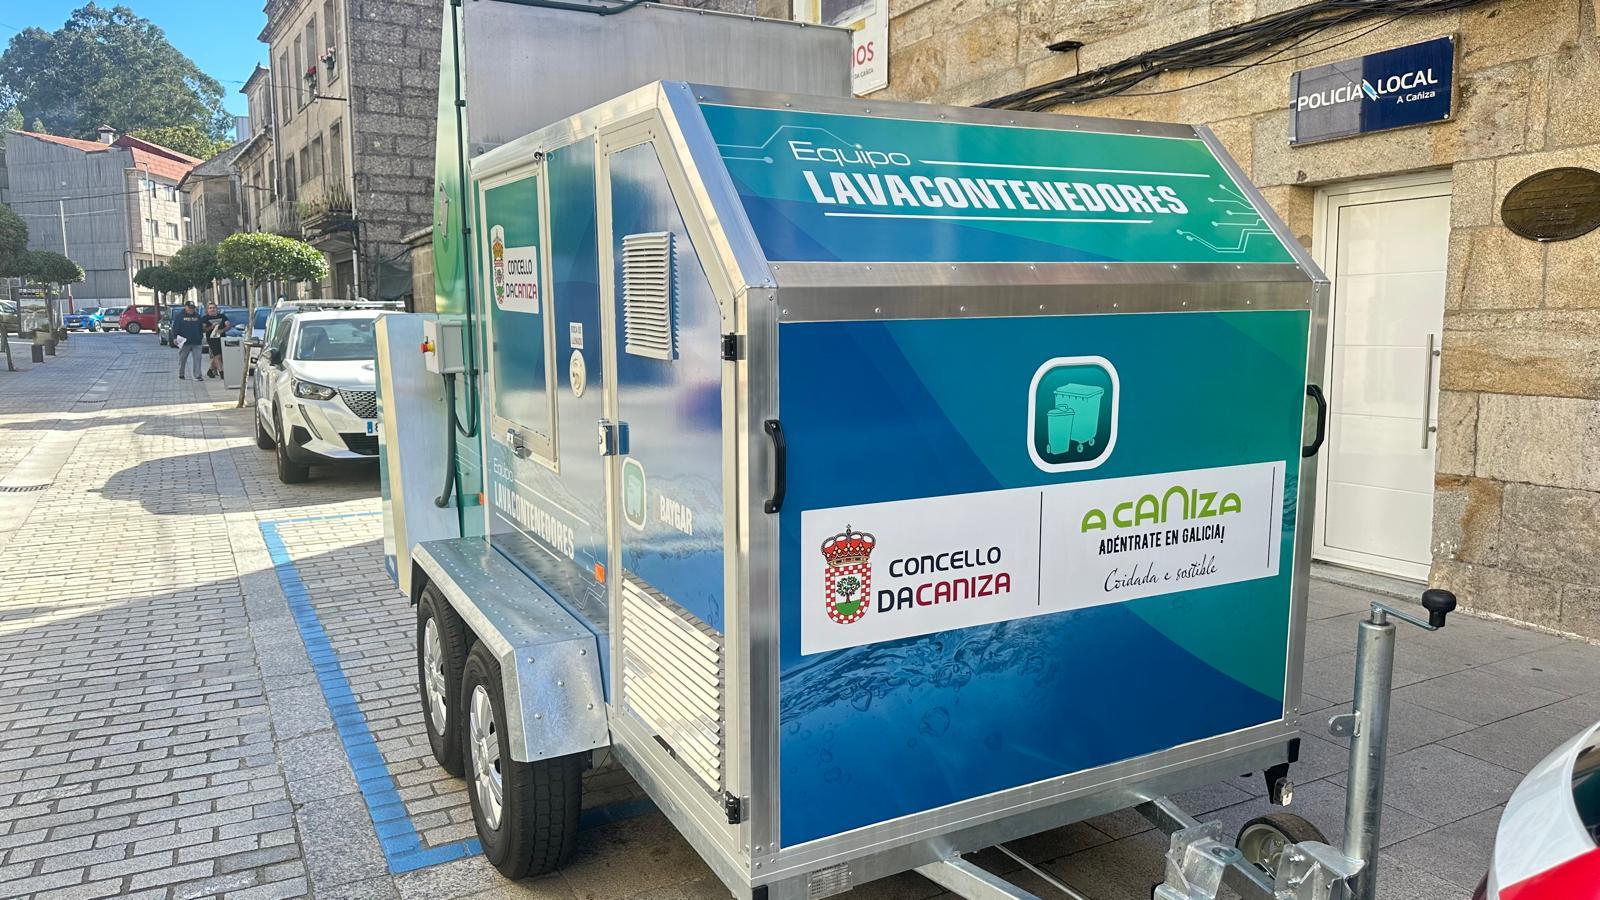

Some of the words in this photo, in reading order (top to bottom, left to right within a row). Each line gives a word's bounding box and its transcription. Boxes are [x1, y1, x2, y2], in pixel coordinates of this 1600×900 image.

[1297, 82, 1364, 112] POLICÍA
[1377, 68, 1438, 95] LOCAL
[1396, 95, 1404, 105] A
[1406, 90, 1436, 102] Cañiza
[788, 140, 911, 167] Equipo
[802, 170, 1188, 215] LAVACONTENEDORES
[508, 259, 532, 275] CONCELLO
[494, 480, 574, 560] LAVACONTENEDORES
[660, 495, 692, 536] BAYGAR
[1081, 508, 1107, 533] A
[1098, 531, 1162, 555] ADÉNTRATE
[1165, 529, 1179, 545] EN
[889, 546, 1001, 577] CONCELLO
[1104, 562, 1159, 592] Coidada
[1164, 572, 1171, 581] e
[1176, 554, 1218, 581] sostible
